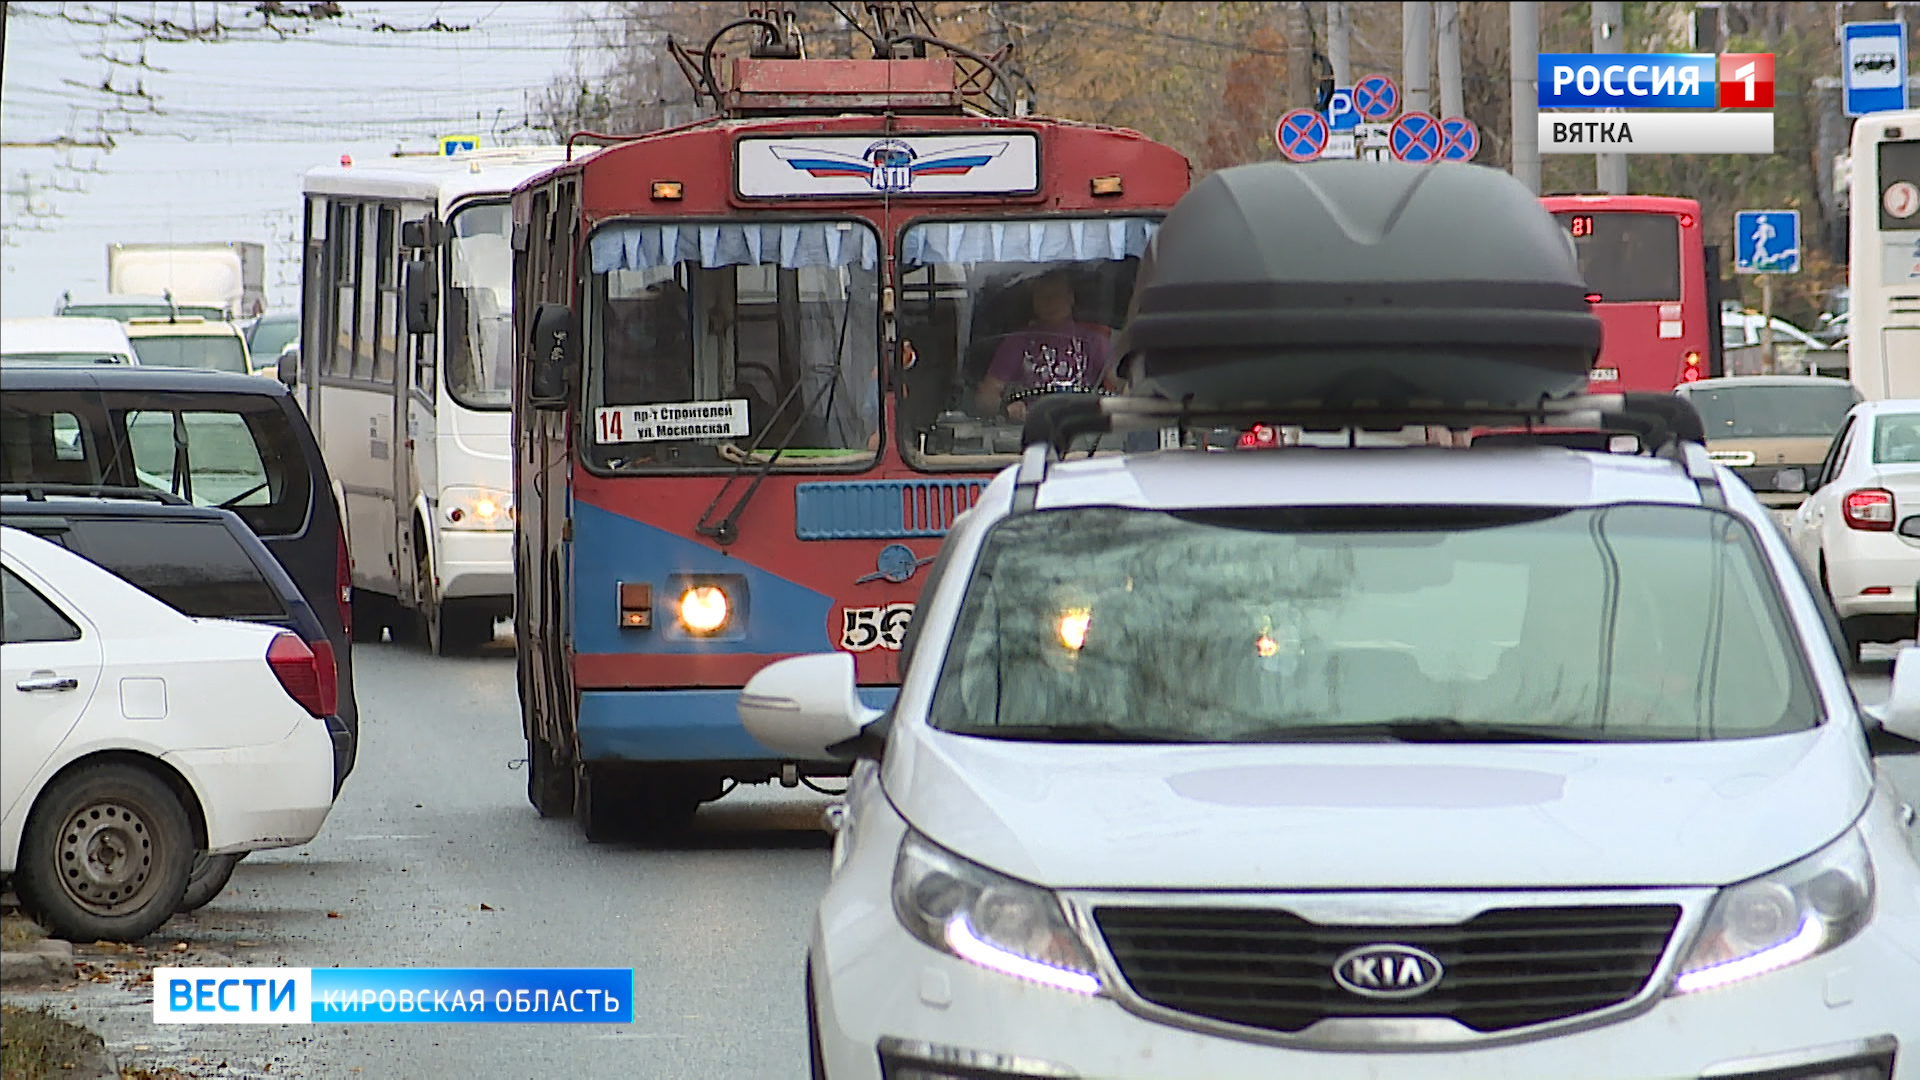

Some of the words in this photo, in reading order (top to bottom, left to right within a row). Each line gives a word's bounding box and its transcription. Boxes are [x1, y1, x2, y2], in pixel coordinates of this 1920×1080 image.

[1329, 93, 1351, 126] P
[871, 167, 911, 188] АТП
[1573, 217, 1592, 236] 81
[634, 409, 658, 422] пр-т
[660, 403, 733, 420] Строителей
[600, 411, 622, 441] 14
[638, 427, 655, 439] ул.
[656, 423, 730, 437] Московская
[1352, 957, 1424, 985] KIA
